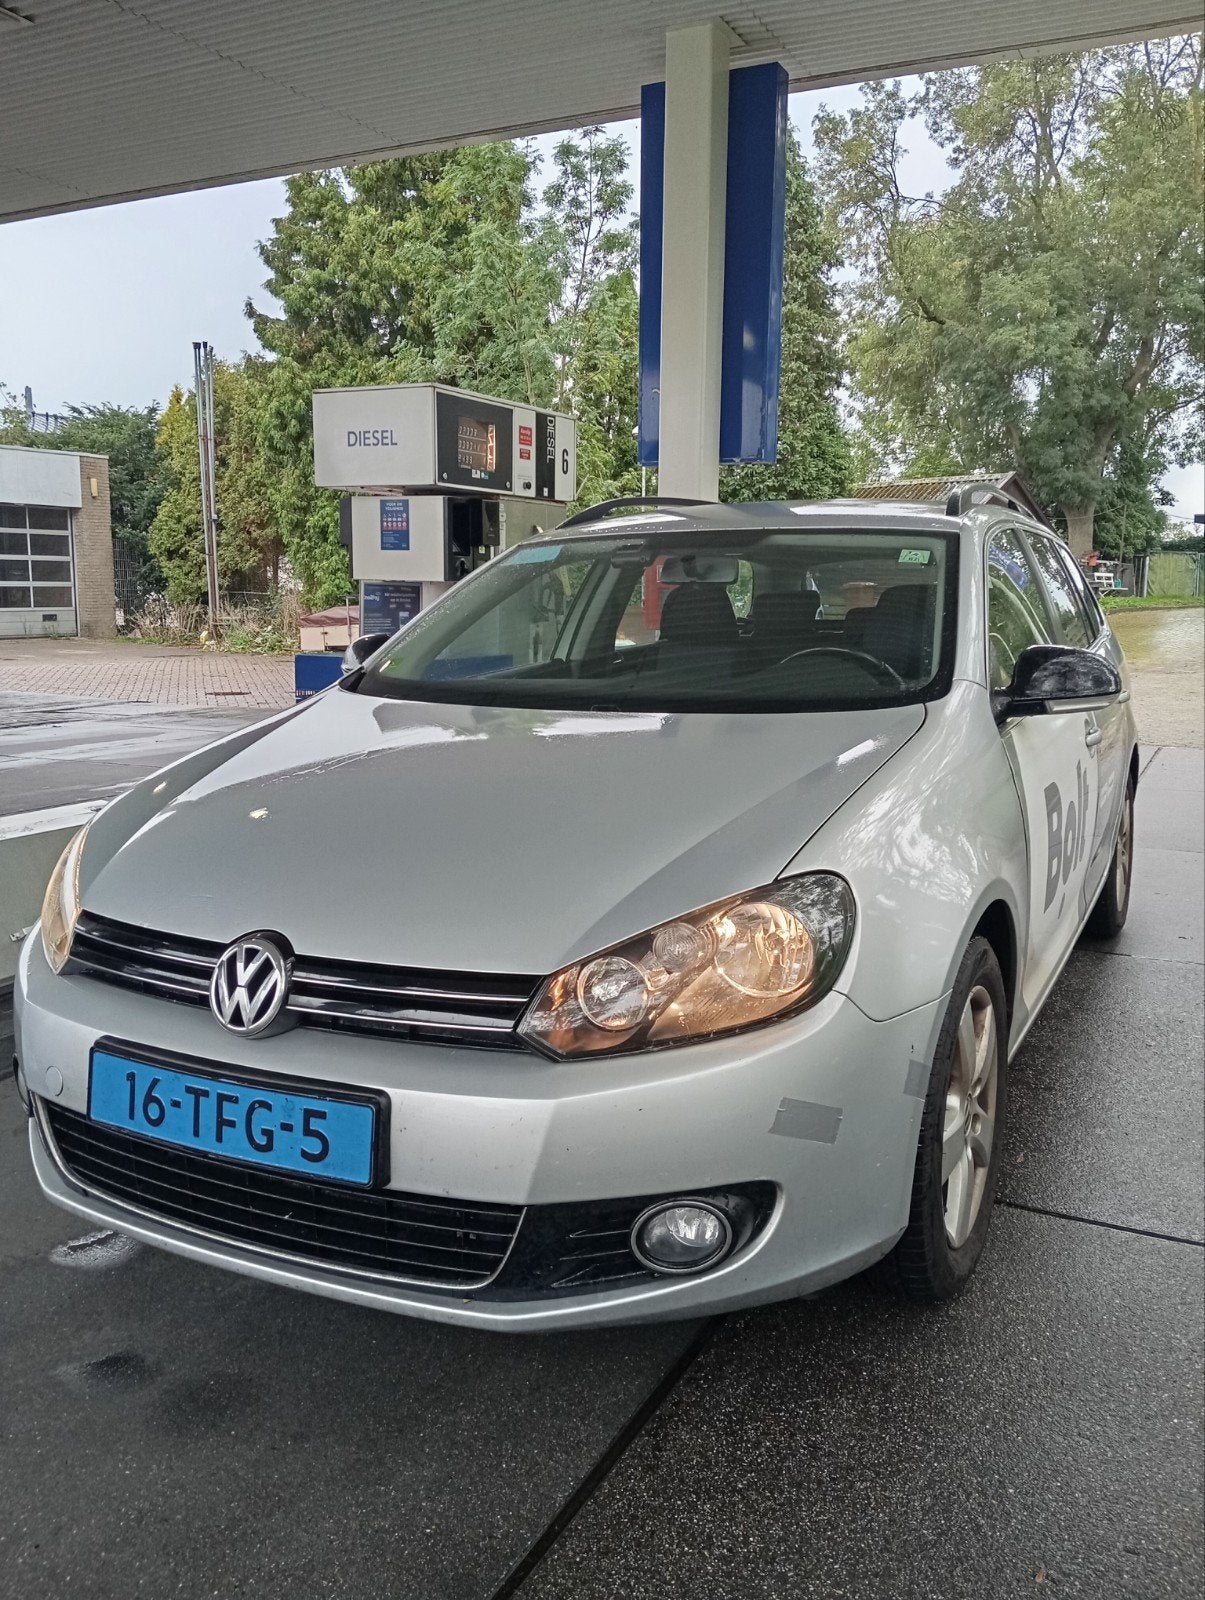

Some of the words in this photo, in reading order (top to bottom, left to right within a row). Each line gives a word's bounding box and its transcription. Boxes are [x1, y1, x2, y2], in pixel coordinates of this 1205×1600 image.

[347, 429, 398, 447] DIESEL
[546, 416, 556, 464] DIESEL
[561, 448, 569, 475] 6
[214, 942, 283, 1033] VW
[125, 1070, 331, 1163] 16-TFG-5
